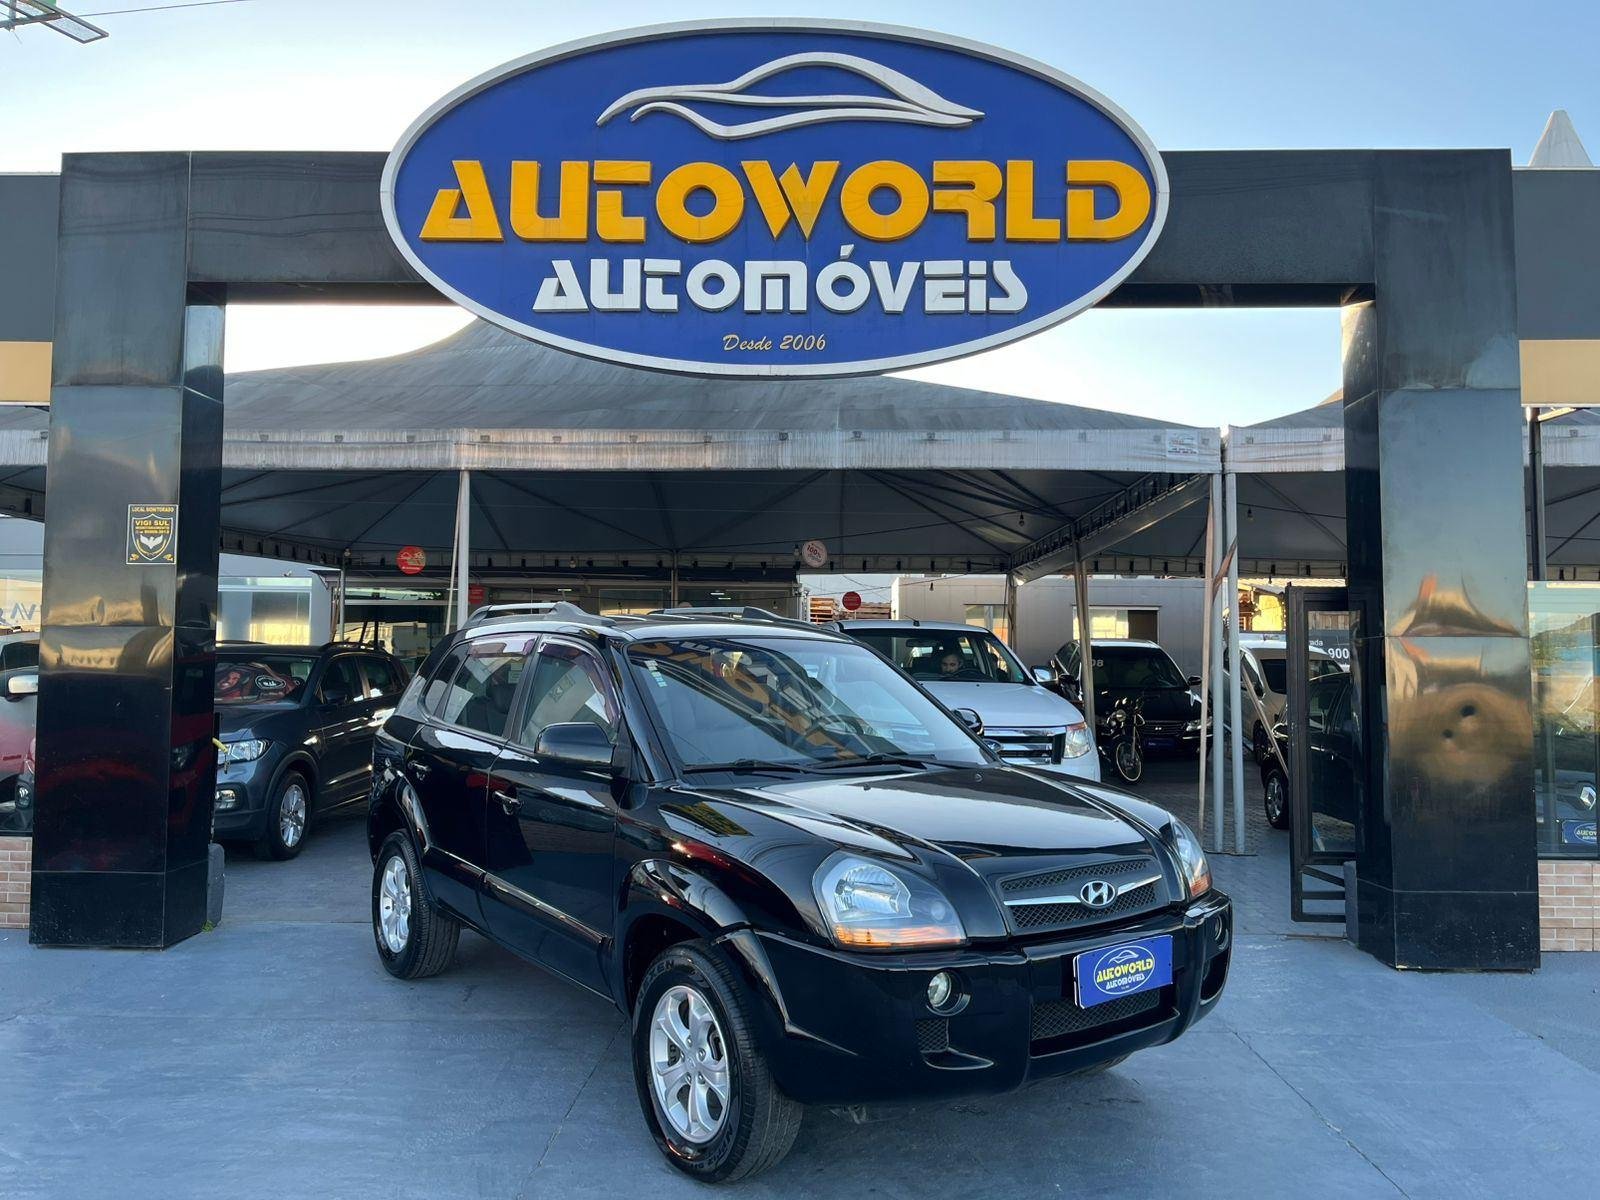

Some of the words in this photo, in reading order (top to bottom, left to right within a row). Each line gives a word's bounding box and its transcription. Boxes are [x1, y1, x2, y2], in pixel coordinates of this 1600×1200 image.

[420, 159, 1151, 243] AUTOWORLD
[532, 244, 1029, 315] AUTOMÓVEIS
[722, 333, 773, 351] Desde
[779, 333, 827, 351] 2006
[1327, 647, 1350, 659] 900
[1096, 958, 1154, 983] AUTOWORLD
